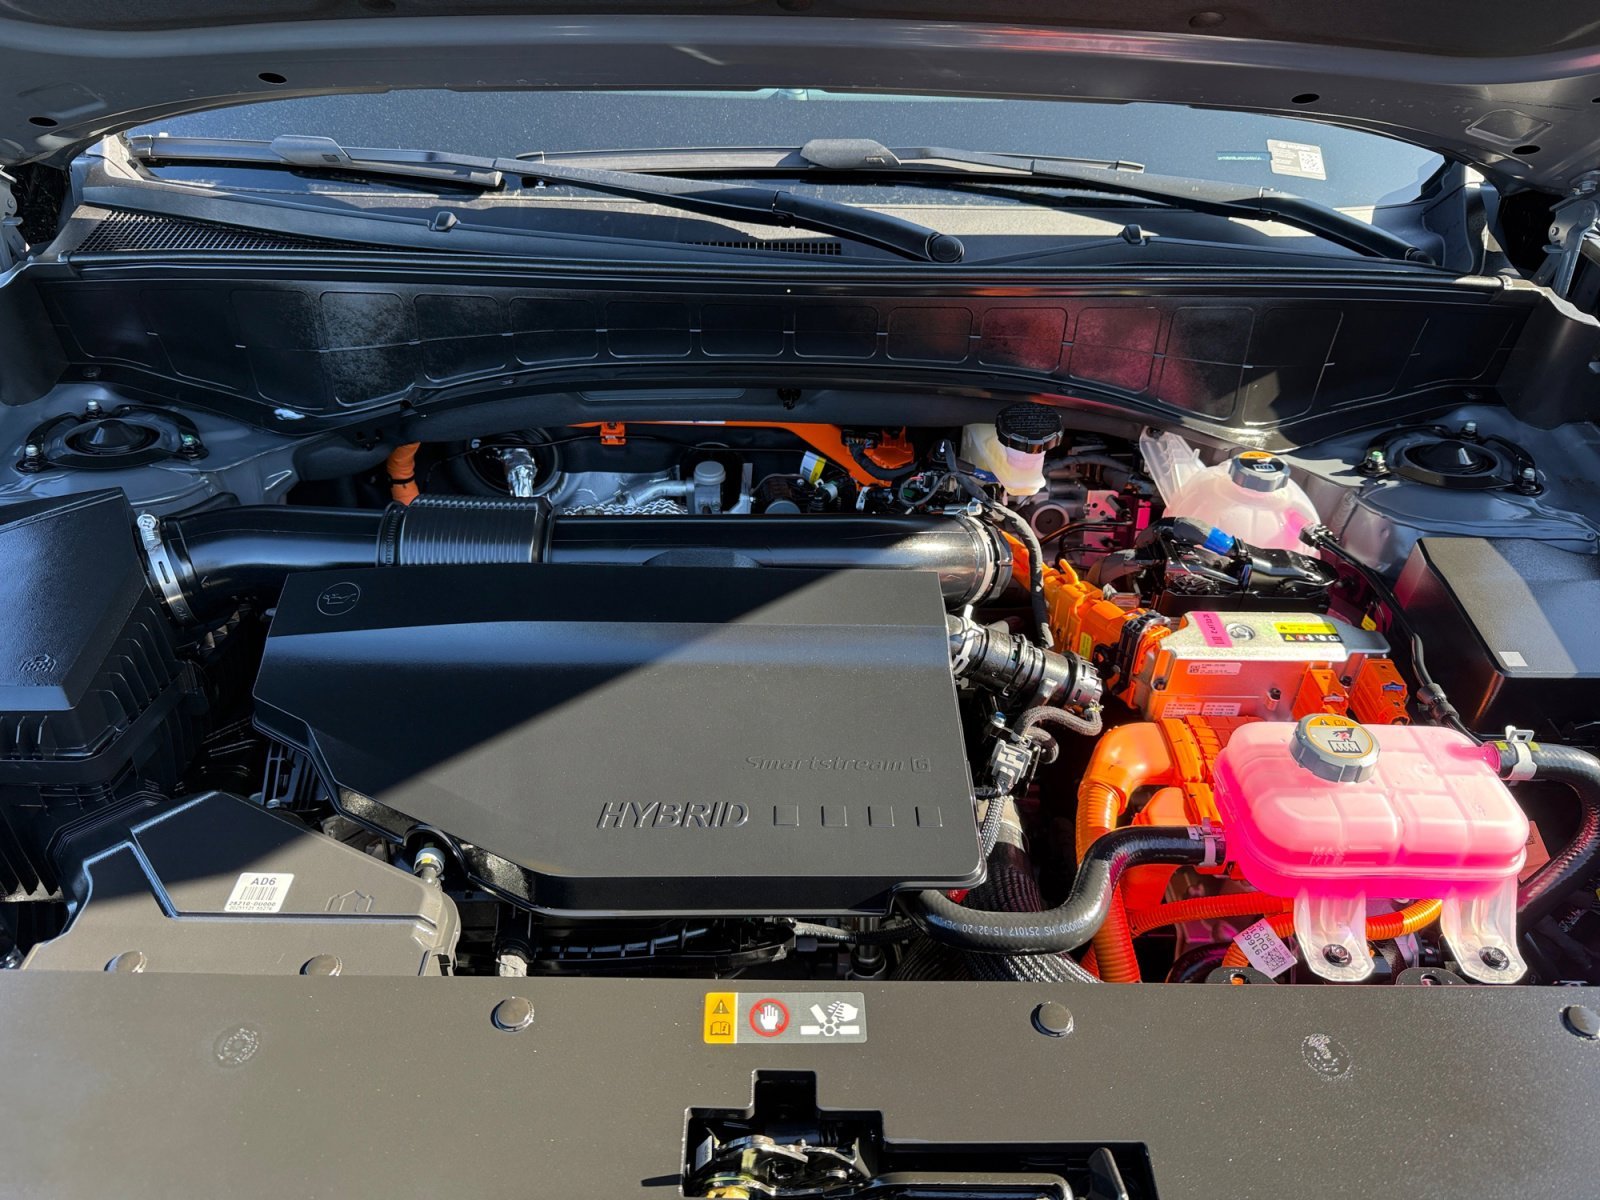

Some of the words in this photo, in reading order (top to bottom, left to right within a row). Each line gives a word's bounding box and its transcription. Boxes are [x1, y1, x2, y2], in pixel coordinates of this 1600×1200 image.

[745, 755, 904, 771] Smartstream
[596, 801, 750, 829] HYBRID
[250, 877, 277, 886] AD6
[962, 923, 1004, 937] 15:32:20
[1009, 925, 1040, 937] 251017
[1045, 926, 1056, 936] HS
[1241, 931, 1263, 956] 91662
